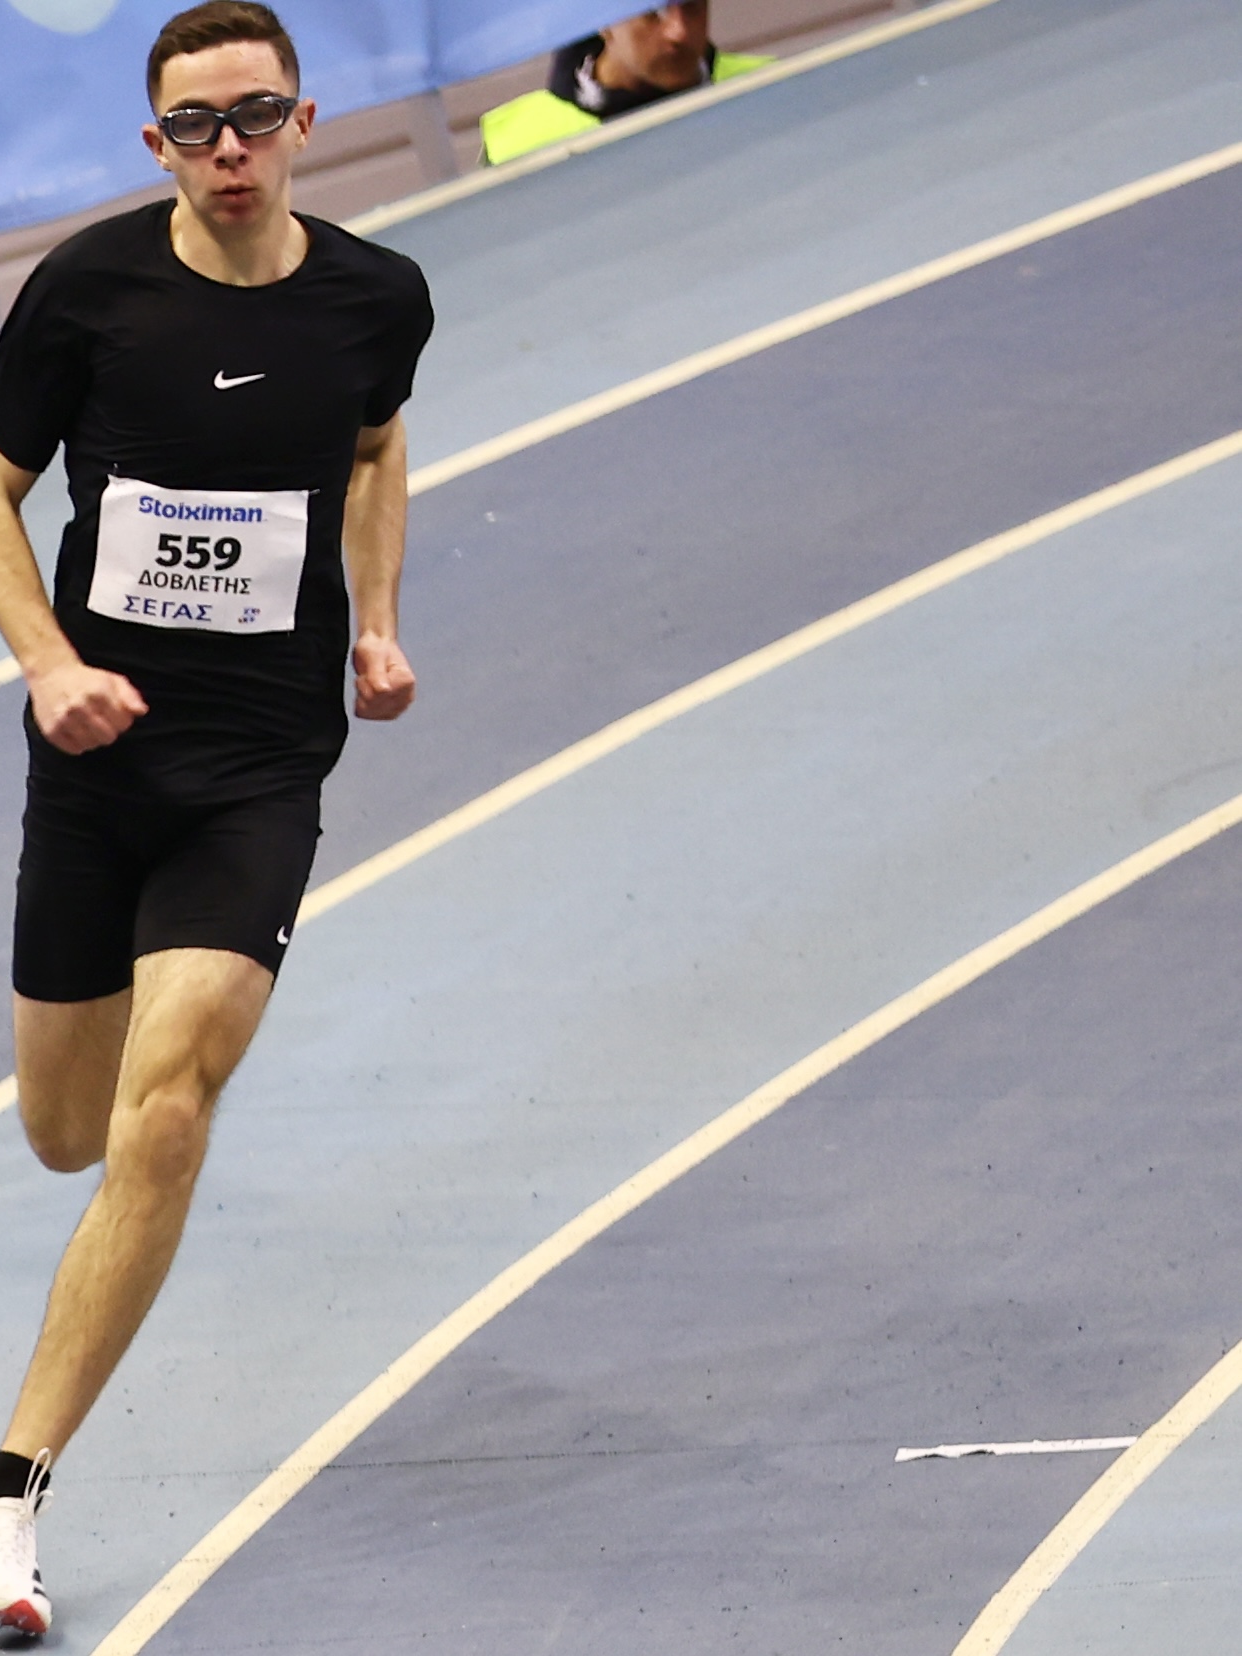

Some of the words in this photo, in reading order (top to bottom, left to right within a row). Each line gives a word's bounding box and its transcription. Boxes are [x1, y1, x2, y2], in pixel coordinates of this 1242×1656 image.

[139, 495, 263, 523] Stoiximan
[154, 532, 242, 572] 559
[138, 569, 252, 595] ΔΟΒΛΕΤΗΣ
[123, 594, 213, 622] ΣΕΓΑΣ
